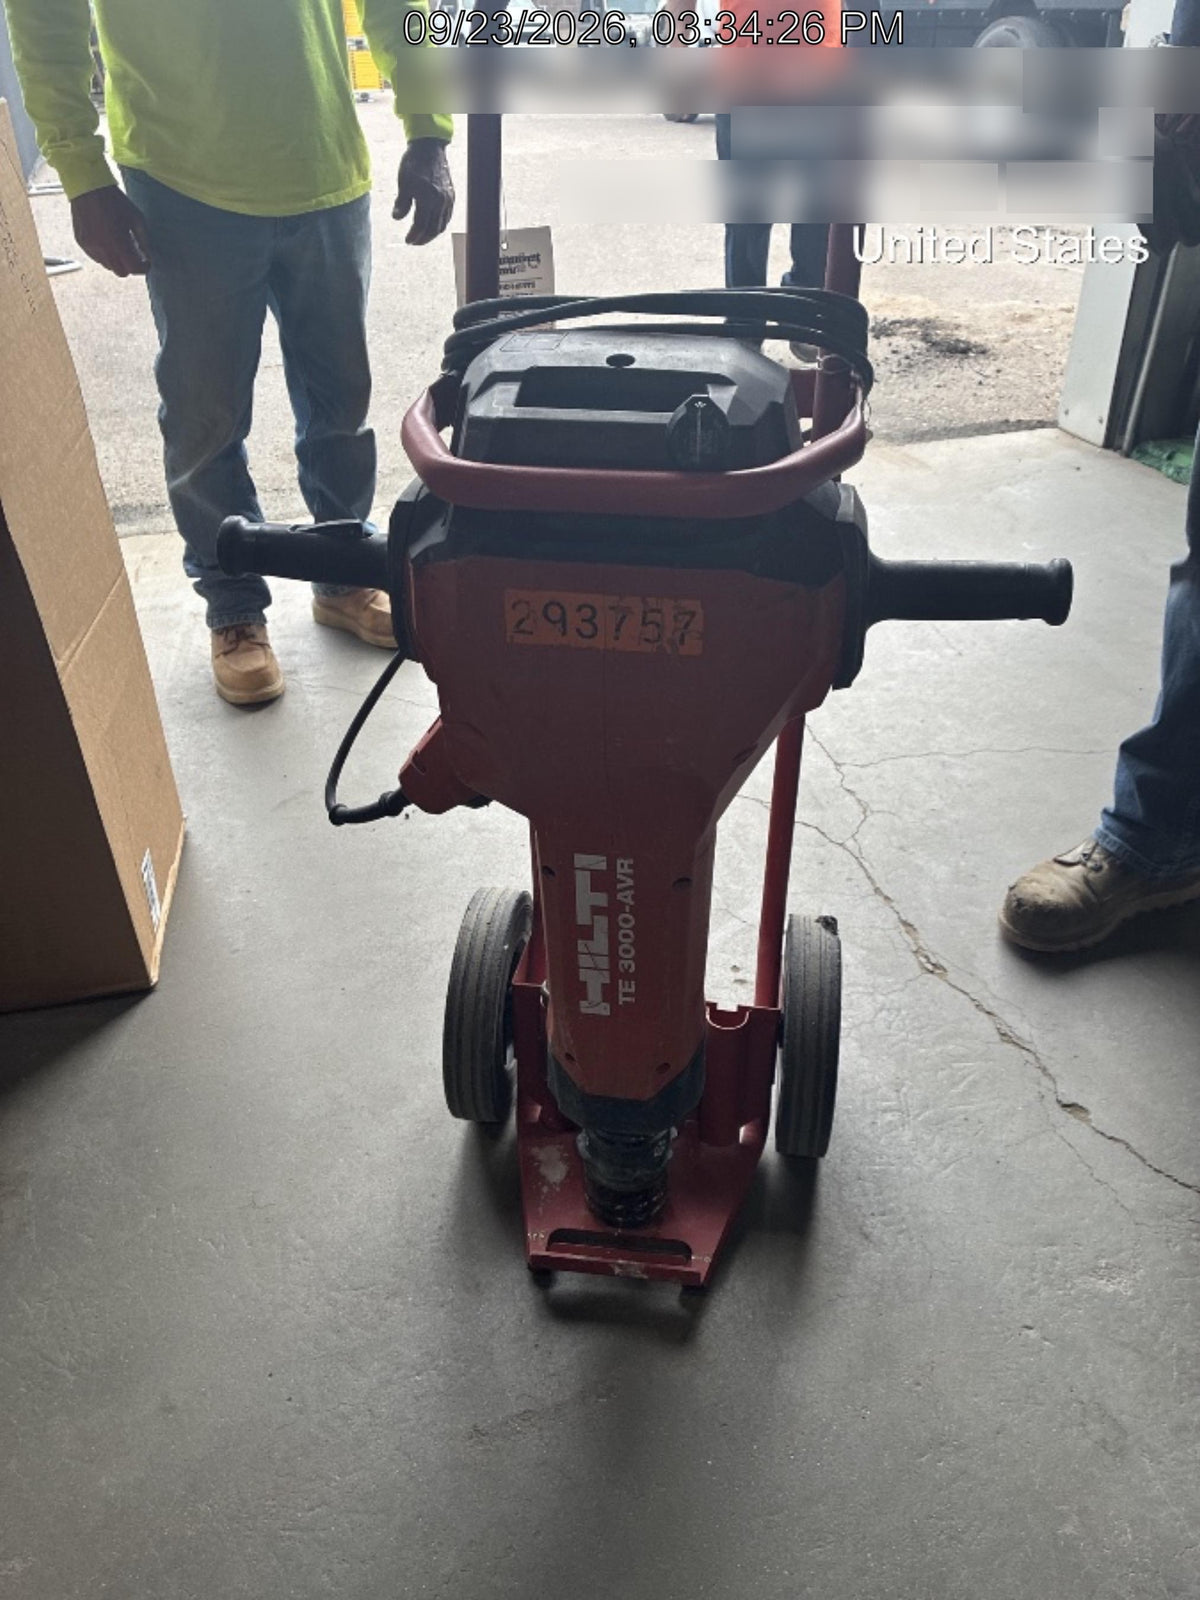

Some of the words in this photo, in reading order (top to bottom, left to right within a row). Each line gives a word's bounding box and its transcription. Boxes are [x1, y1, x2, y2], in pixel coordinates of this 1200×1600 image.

[511, 600, 698, 646] 293757
[573, 852, 611, 1017] HILTI
[615, 857, 636, 974] 3000-AVR
[617, 979, 636, 1006] TE
